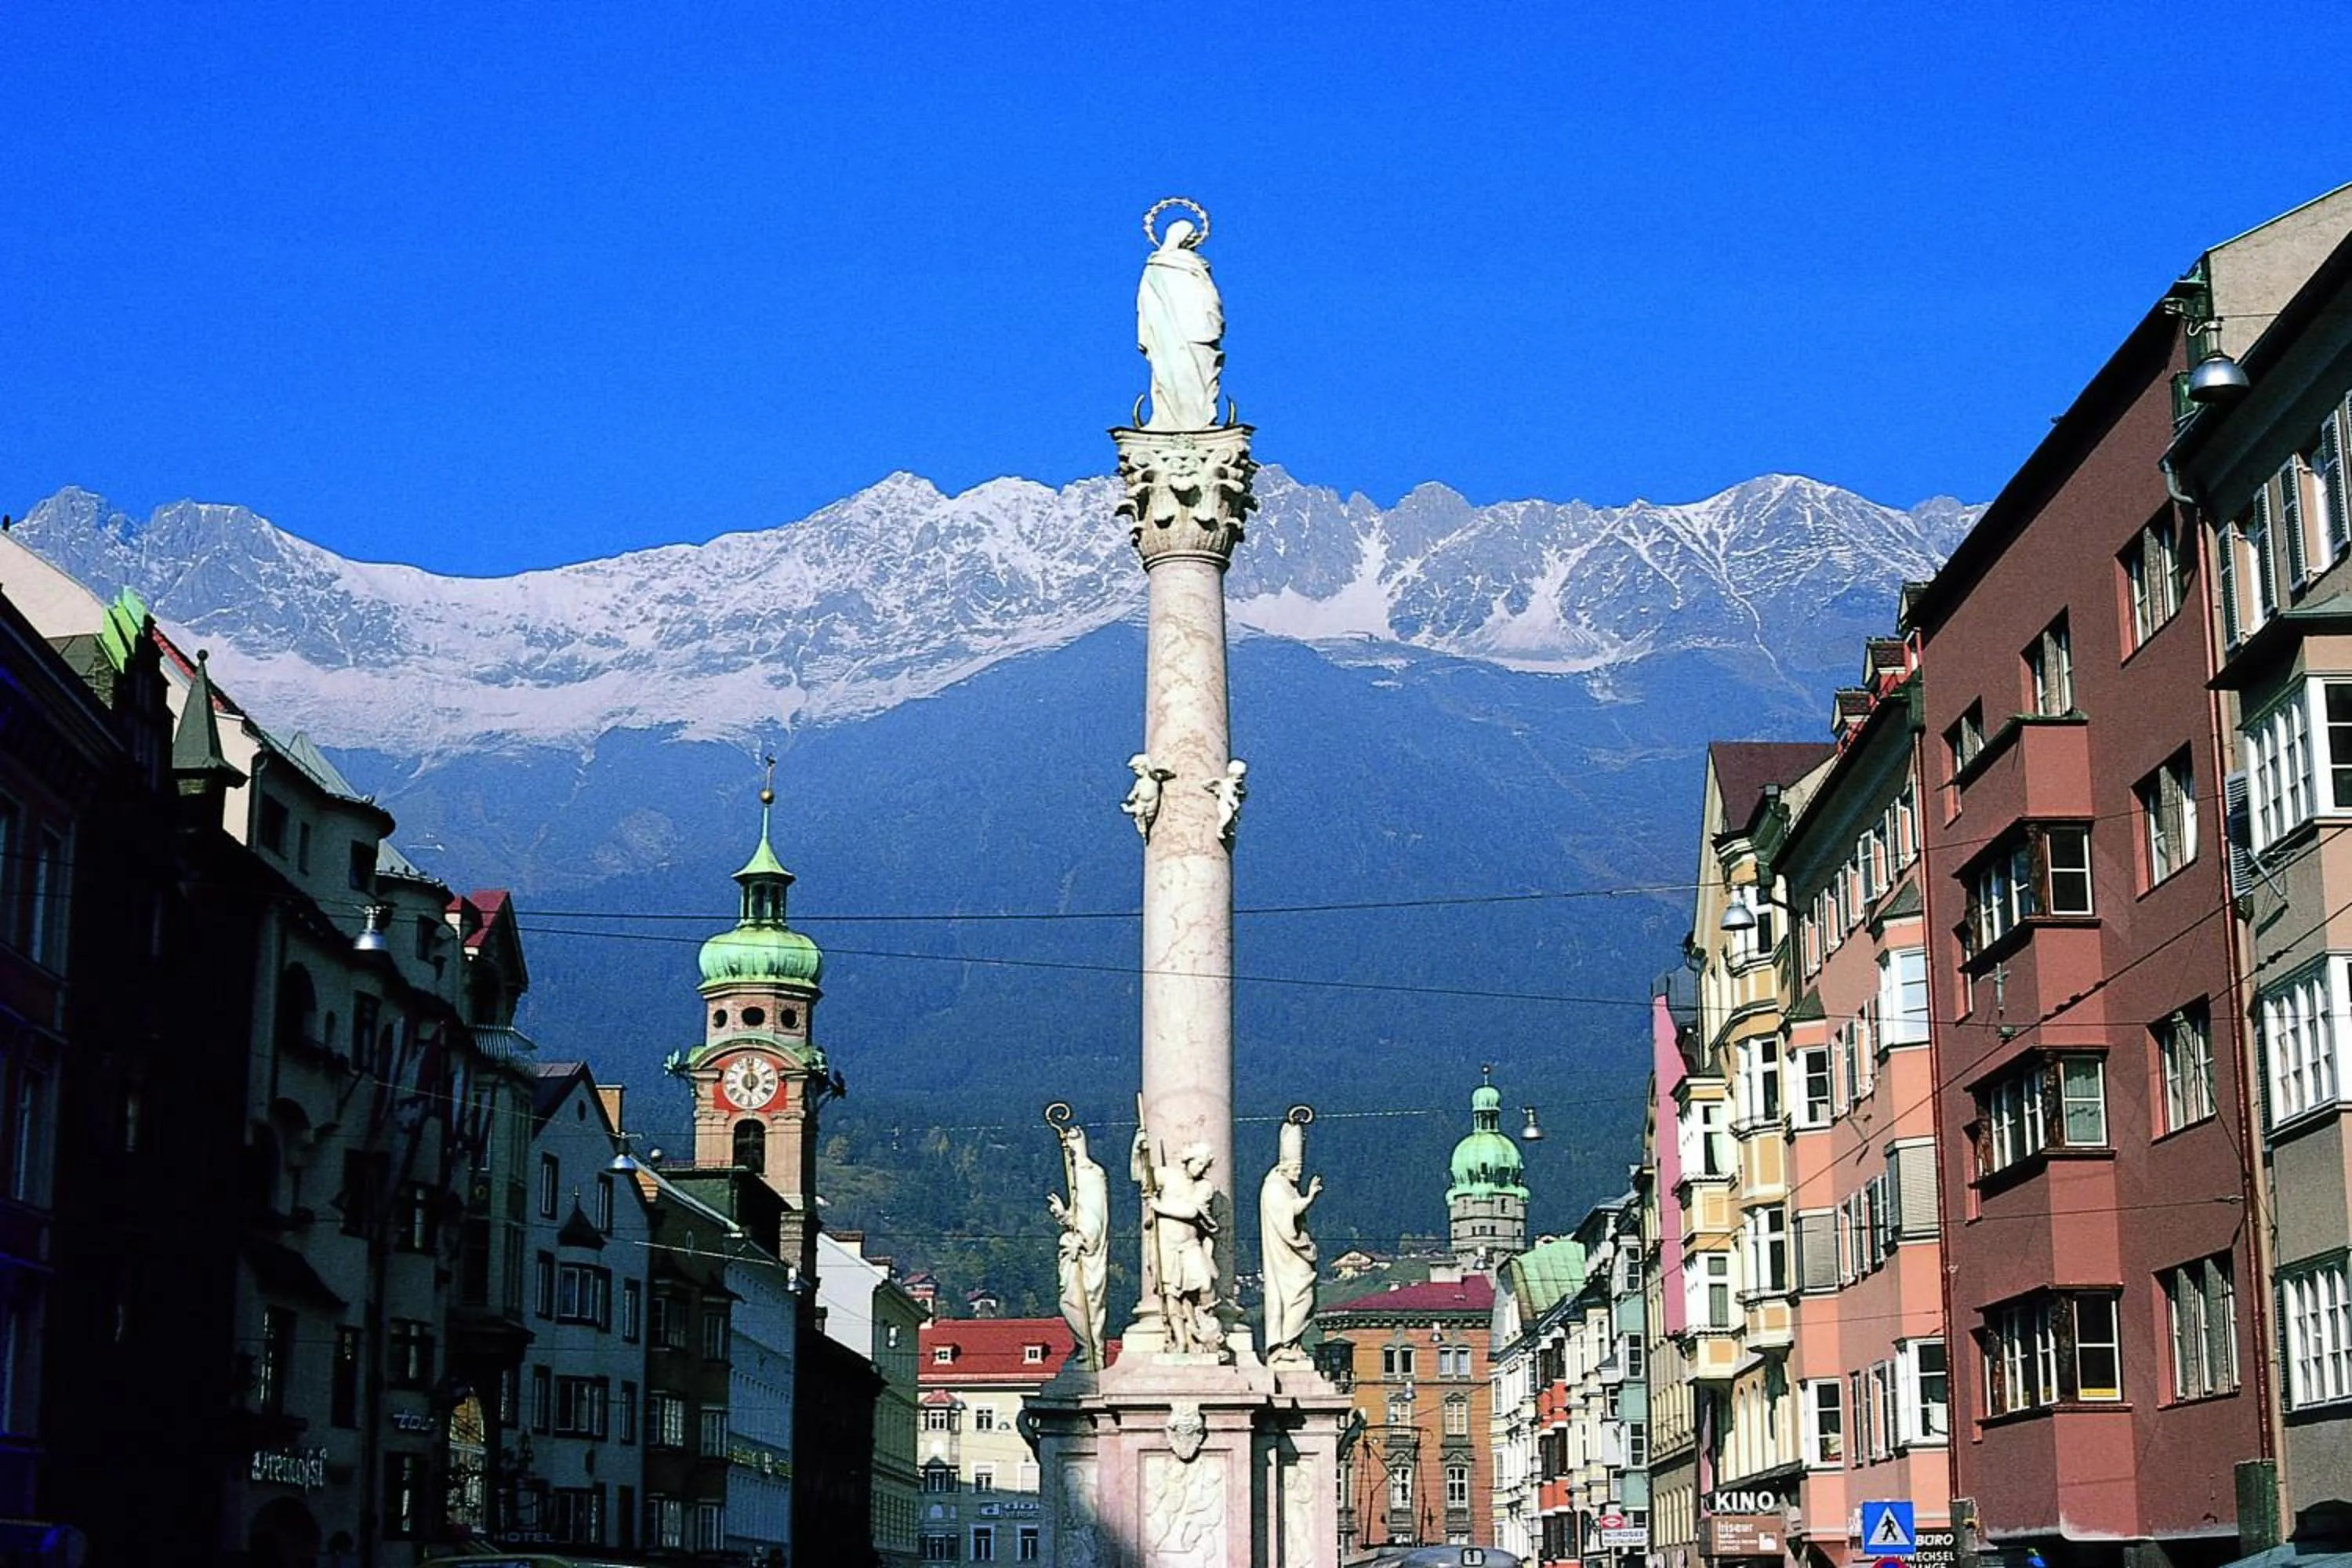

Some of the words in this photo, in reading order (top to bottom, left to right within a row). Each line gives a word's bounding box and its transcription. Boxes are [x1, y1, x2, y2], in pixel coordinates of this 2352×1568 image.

[1715, 1491, 1775, 1512] KINO
[492, 1531, 556, 1544] HOTEL
[1467, 1551, 1475, 1563] 1
